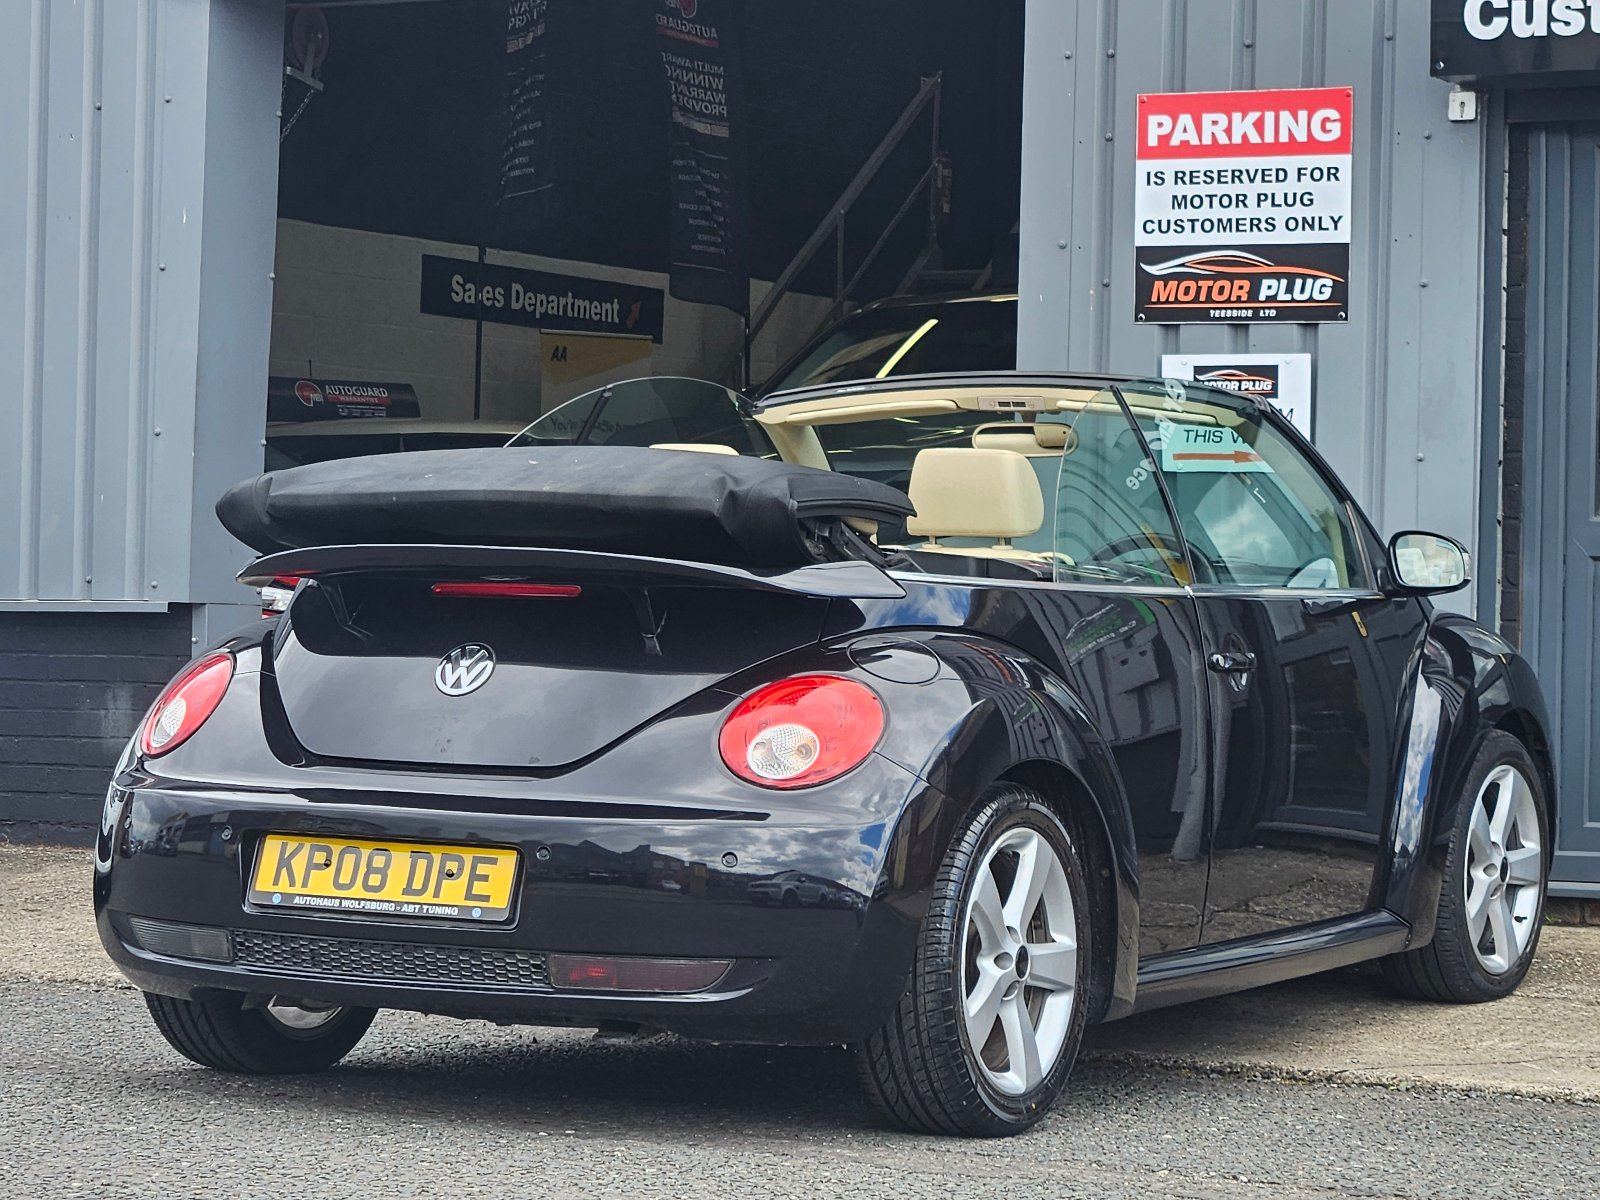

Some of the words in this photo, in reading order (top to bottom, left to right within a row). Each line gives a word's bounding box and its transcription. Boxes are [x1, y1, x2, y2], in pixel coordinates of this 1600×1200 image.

[1147, 108, 1342, 147] PARKING
[1146, 170, 1166, 186] IS
[1174, 167, 1288, 185] RESERVED
[1297, 166, 1341, 183] FOR
[1171, 193, 1248, 210] MOTOR
[1256, 192, 1314, 208] PLUG
[1142, 216, 1277, 234] CUSTOMERS
[1284, 215, 1343, 232] ONLY
[451, 274, 504, 308] Saes
[510, 282, 620, 324] Department
[1151, 280, 1250, 302] MOTOR
[1258, 278, 1333, 301] PLUG
[1210, 309, 1253, 318] TEESSIDE
[1260, 309, 1276, 318] LTD
[550, 345, 568, 362] AA
[325, 384, 388, 398] AUTOGUARD
[1240, 380, 1273, 391] PLUG
[1183, 429, 1223, 444] THIS
[272, 841, 392, 893] KP08
[402, 851, 498, 903] DPE
[293, 896, 340, 908] AUTOHAUS
[341, 898, 395, 911] WOLFSBURG
[401, 903, 419, 913] ABT
[422, 905, 458, 916] TUNING
